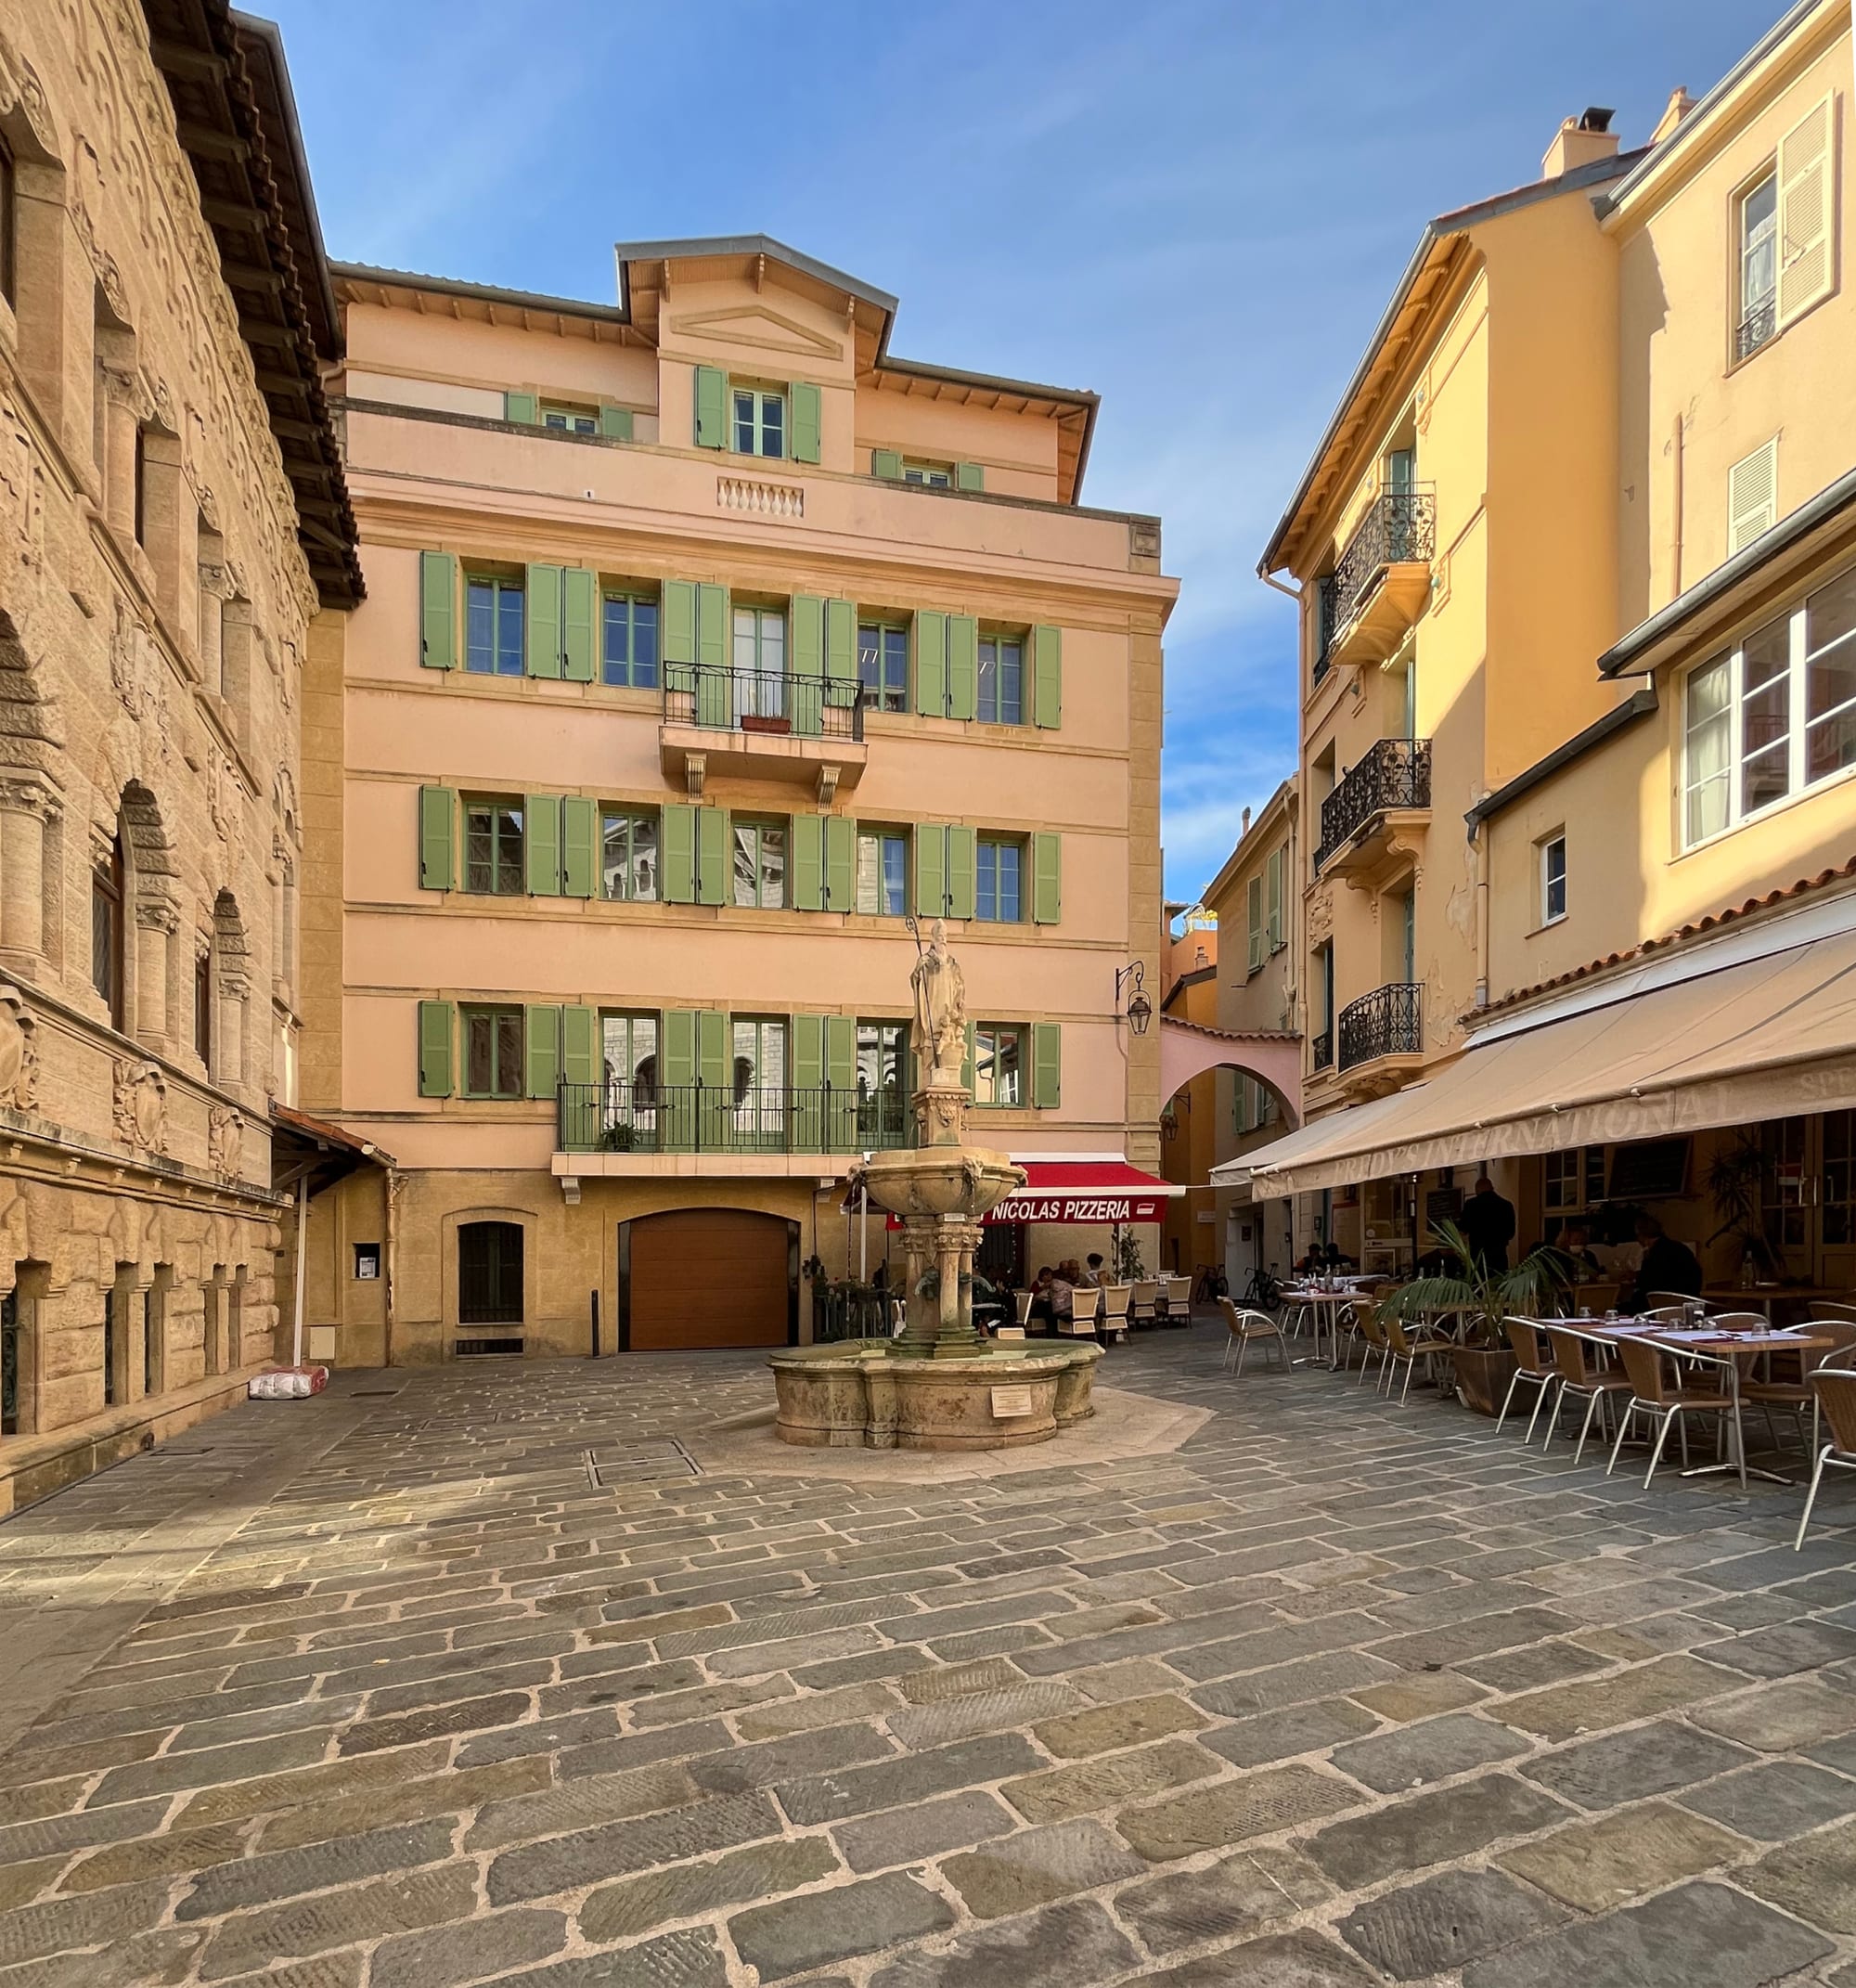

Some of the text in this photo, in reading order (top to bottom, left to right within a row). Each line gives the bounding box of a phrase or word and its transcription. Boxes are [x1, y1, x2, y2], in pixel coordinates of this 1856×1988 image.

[1424, 1081, 1745, 1168] INTERNATIONAL
[992, 1201, 1060, 1220] NICOLAS
[1063, 1200, 1130, 1220] PIZZERIA
